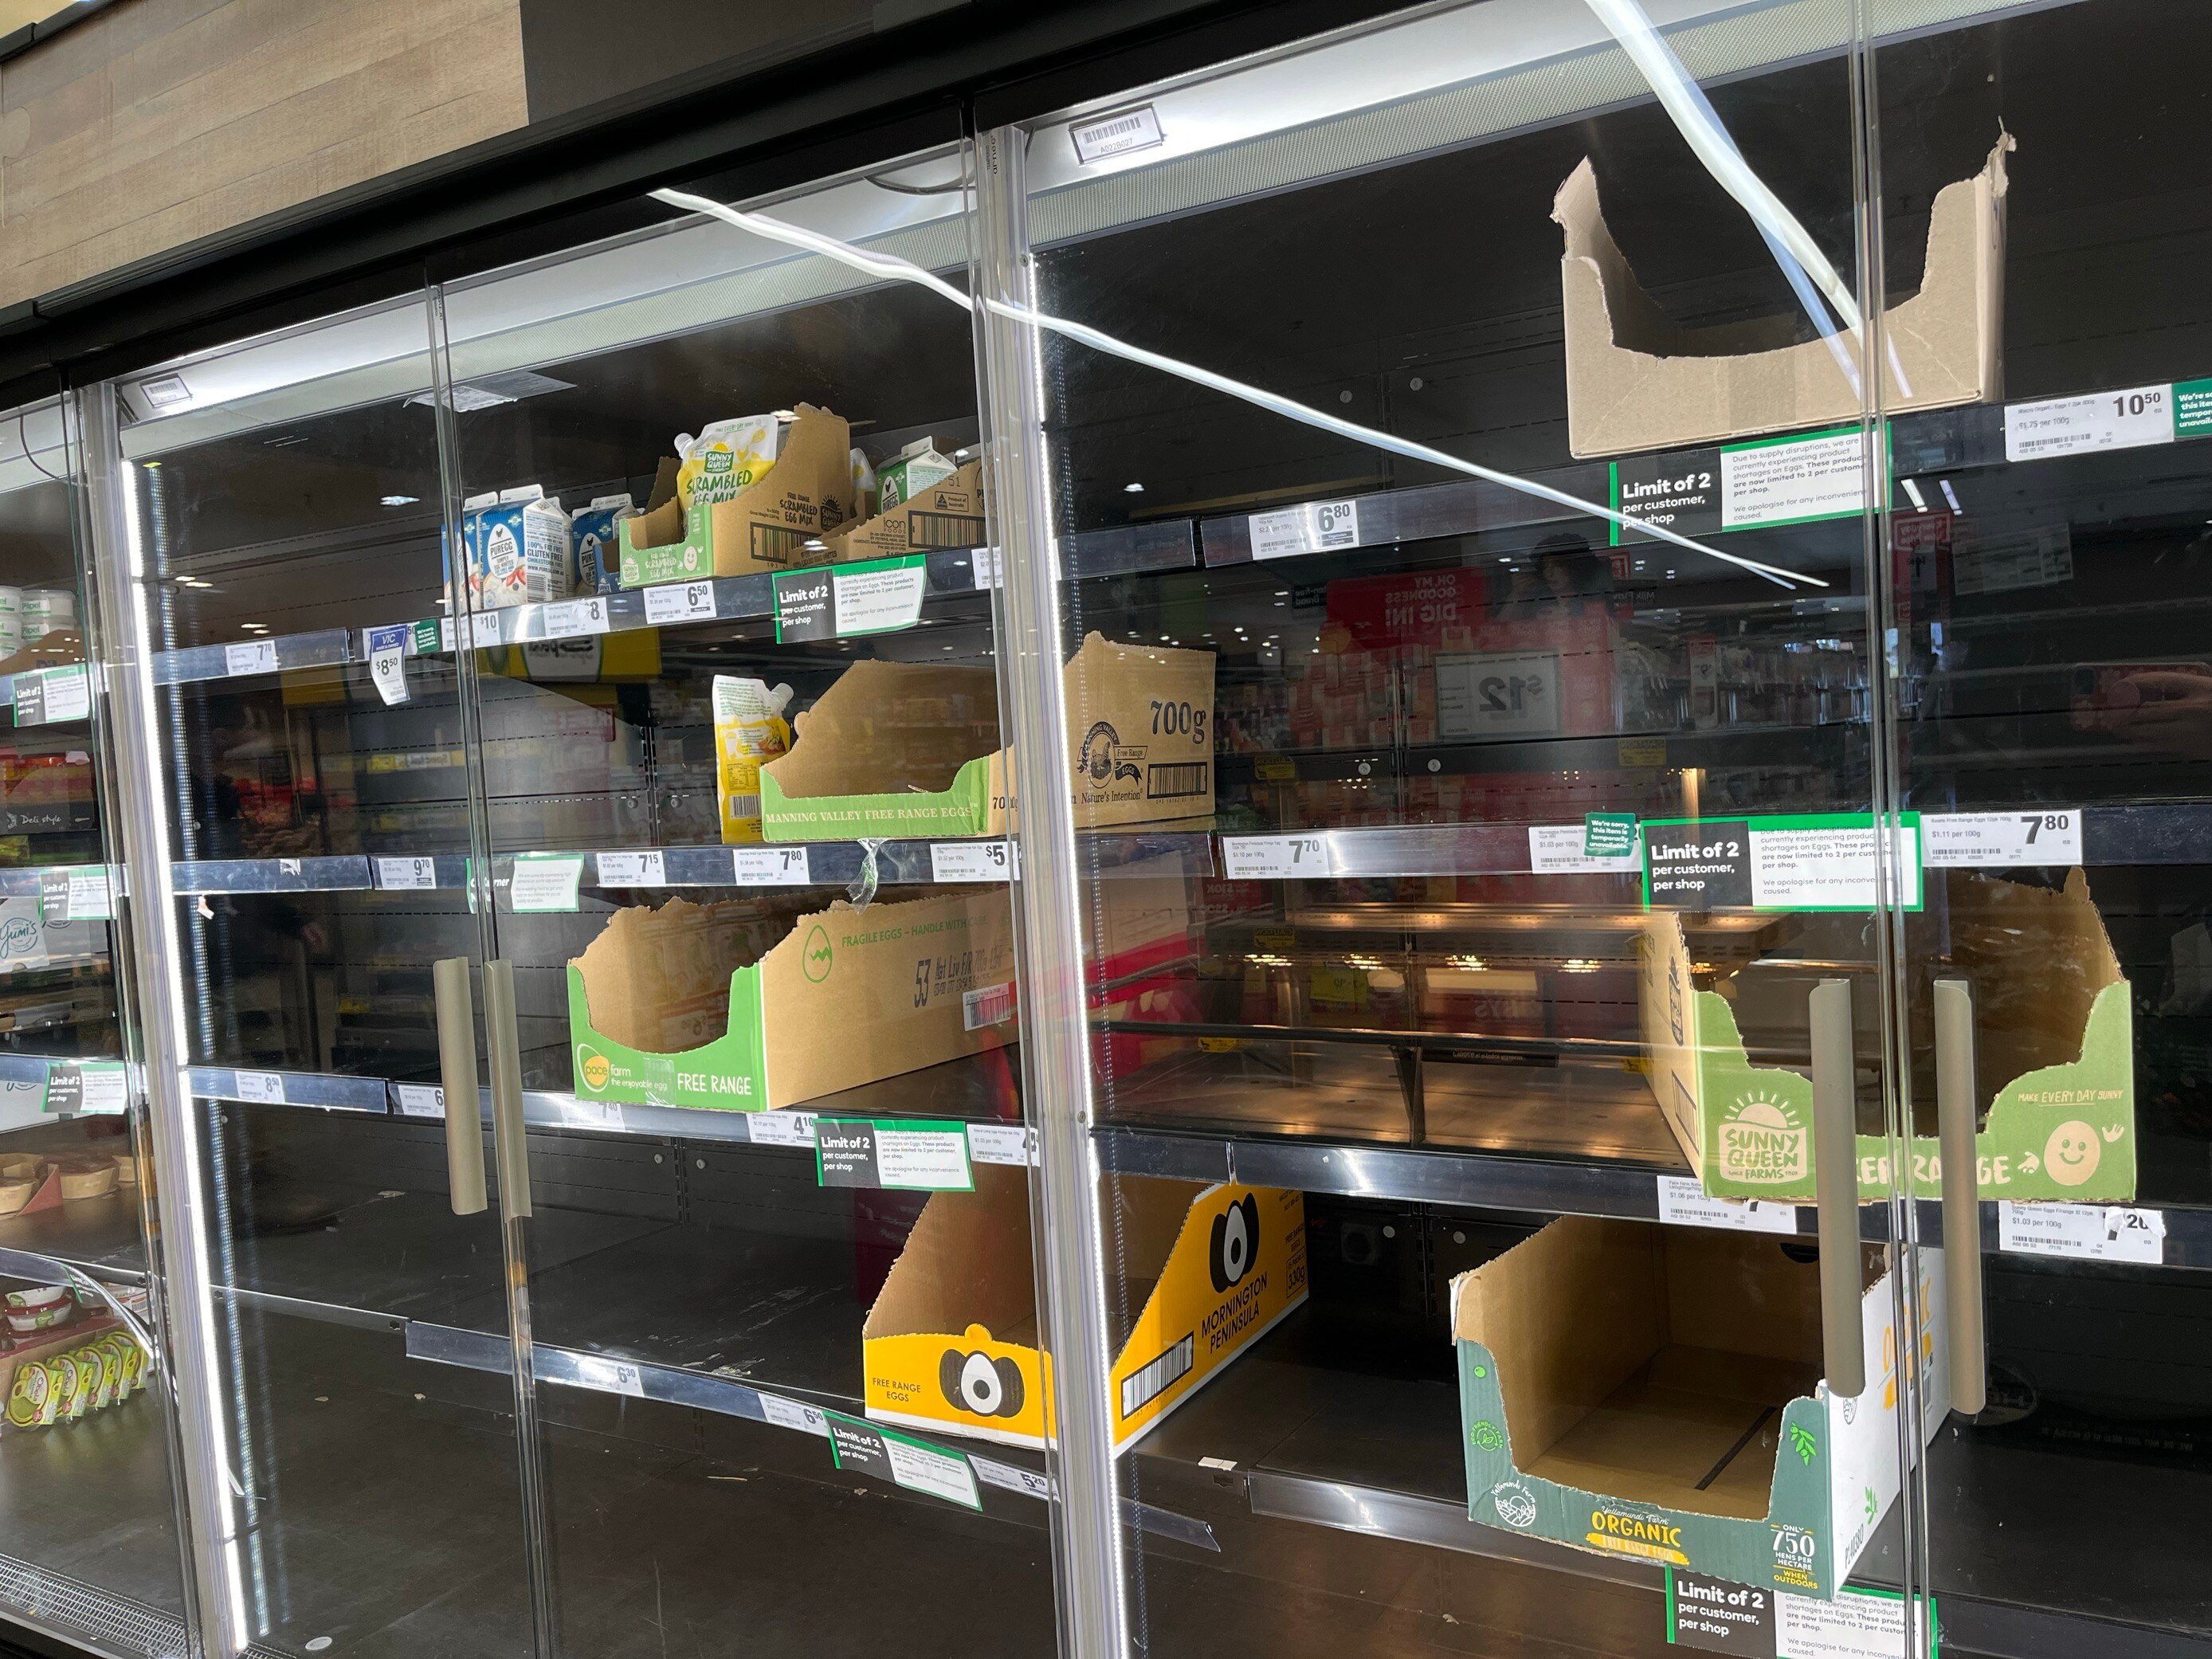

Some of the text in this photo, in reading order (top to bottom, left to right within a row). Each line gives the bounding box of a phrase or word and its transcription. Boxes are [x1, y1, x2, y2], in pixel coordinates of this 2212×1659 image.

[2178, 391, 2201, 402] We're
[2180, 402, 2198, 410] this
[2018, 416, 2071, 430] $1.75 100g
[707, 453, 732, 461] SUNNY
[1759, 447, 1786, 460] supply
[1786, 441, 1831, 455] disruptions,
[1732, 447, 1850, 473] currently experiencing product
[1733, 458, 1831, 480] shortages Eggs. These
[687, 469, 753, 495] SCRAMBLED
[1748, 469, 1829, 487] now limited per
[1622, 473, 1712, 499] Limit of 2
[1749, 485, 1771, 496] shop.
[779, 499, 818, 516] SCRAMBLED
[1622, 494, 1707, 516] per customer,
[1748, 496, 1814, 512] apologise for any
[785, 511, 798, 524] EGG
[798, 514, 814, 526] MIX
[1622, 512, 1676, 531] per shop
[490, 542, 513, 555] PUREGG
[527, 548, 564, 563] GLUTEN FREE
[779, 585, 828, 604] Limit of 2
[780, 602, 826, 617] per customer,
[480, 614, 496, 629] $10
[782, 616, 811, 628] per shop
[382, 633, 396, 644] VIC
[17, 689, 30, 699] Limit
[1151, 700, 1207, 744] 700g
[1117, 748, 1143, 759] Free Range
[1121, 765, 1135, 775] EGGS
[1081, 790, 1111, 805] Nature's
[21, 815, 61, 826] Deli style
[765, 805, 972, 824] MANNING VALLEY FREE RANGE EGGS
[1760, 832, 1845, 845] currently experiencing
[1651, 841, 1740, 861] Limit of 2
[1761, 843, 1799, 853] shortages
[1794, 850, 1823, 859] limited
[1652, 861, 1735, 878] per customer,
[43, 883, 57, 893] Limit
[1653, 877, 1706, 892] per shop
[1775, 877, 1814, 888] apologise
[841, 917, 967, 947] FRAGILE EGGS HANDLE WITH
[914, 958, 931, 1008] 53
[586, 1064, 631, 1077] pace farm
[50, 1076, 68, 1085] Limit
[622, 1078, 653, 1089] enjoyable
[654, 1082, 668, 1092] egg
[677, 1073, 752, 1096] FREE RANGE
[2018, 1089, 2124, 1104] MAKE EVERY DAY SUNNY
[821, 1137, 870, 1149] Limit of 2
[1725, 1128, 1800, 1153] SUNNY
[834, 1152, 868, 1162] customer,
[1727, 1149, 1799, 1169] QUEEN
[836, 1163, 853, 1172] shop
[1744, 1168, 1786, 1180] FARMS
[2012, 1217, 2062, 1230] $1.03 per 100g
[1288, 1265, 1306, 1291] 330g
[1201, 1271, 1269, 1339] MORNINGTON
[1210, 1300, 1261, 1355] PENINSULA
[872, 1377, 922, 1394] FREE RANGE
[886, 1390, 910, 1403] EGGS
[833, 1427, 873, 1447] Limit of
[837, 1441, 882, 1460] per customer,
[851, 1450, 869, 1463] shop
[1489, 1480, 1537, 1504] Yallamundi Farm
[1601, 1505, 1671, 1525] Yallamundi Farm
[1591, 1511, 1682, 1548] ORGANIC
[1783, 1524, 1805, 1532] ONLY
[1770, 1528, 1816, 1558] 750
[1775, 1551, 1813, 1564] HENS PER
[1778, 1558, 1813, 1571] HECTARE
[1773, 1574, 1818, 1590] OUTDOORS
[1783, 1569, 1808, 1580] WHEN
[1677, 1580, 1764, 1609] Limit of 2
[1678, 1602, 1759, 1626] per customer,
[1786, 1602, 1822, 1615] shortages
[1679, 1618, 1730, 1637] per shop
[1801, 1640, 1837, 1652] apologise
